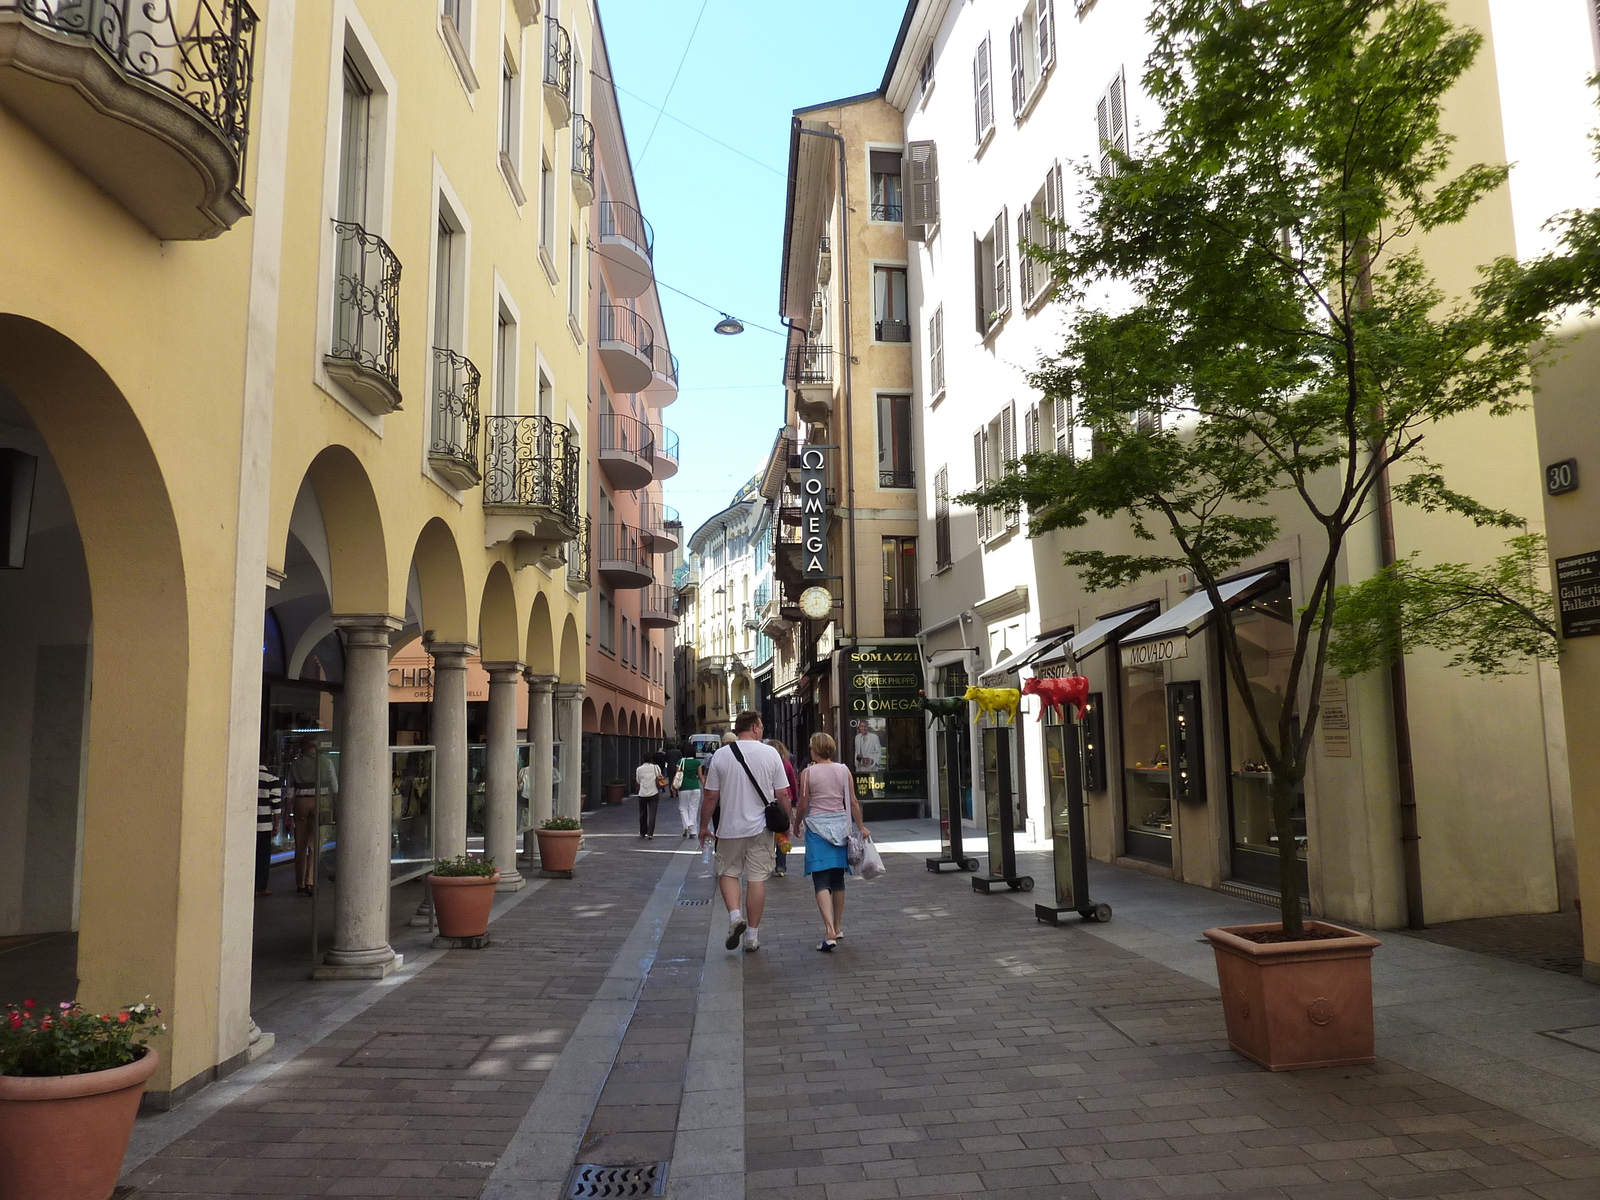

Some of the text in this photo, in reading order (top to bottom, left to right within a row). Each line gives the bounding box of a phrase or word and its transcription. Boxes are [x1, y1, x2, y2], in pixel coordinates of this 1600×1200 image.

[1550, 464, 1571, 489] 30
[804, 478, 824, 572] OMEGA
[1562, 596, 1600, 612] Palladi
[851, 653, 918, 662] SOMAZZI
[1130, 641, 1173, 664] MOVADO
[388, 668, 434, 687] CHR
[868, 677, 915, 685] PATEK PHILIPPE
[868, 699, 918, 710] OMEGA
